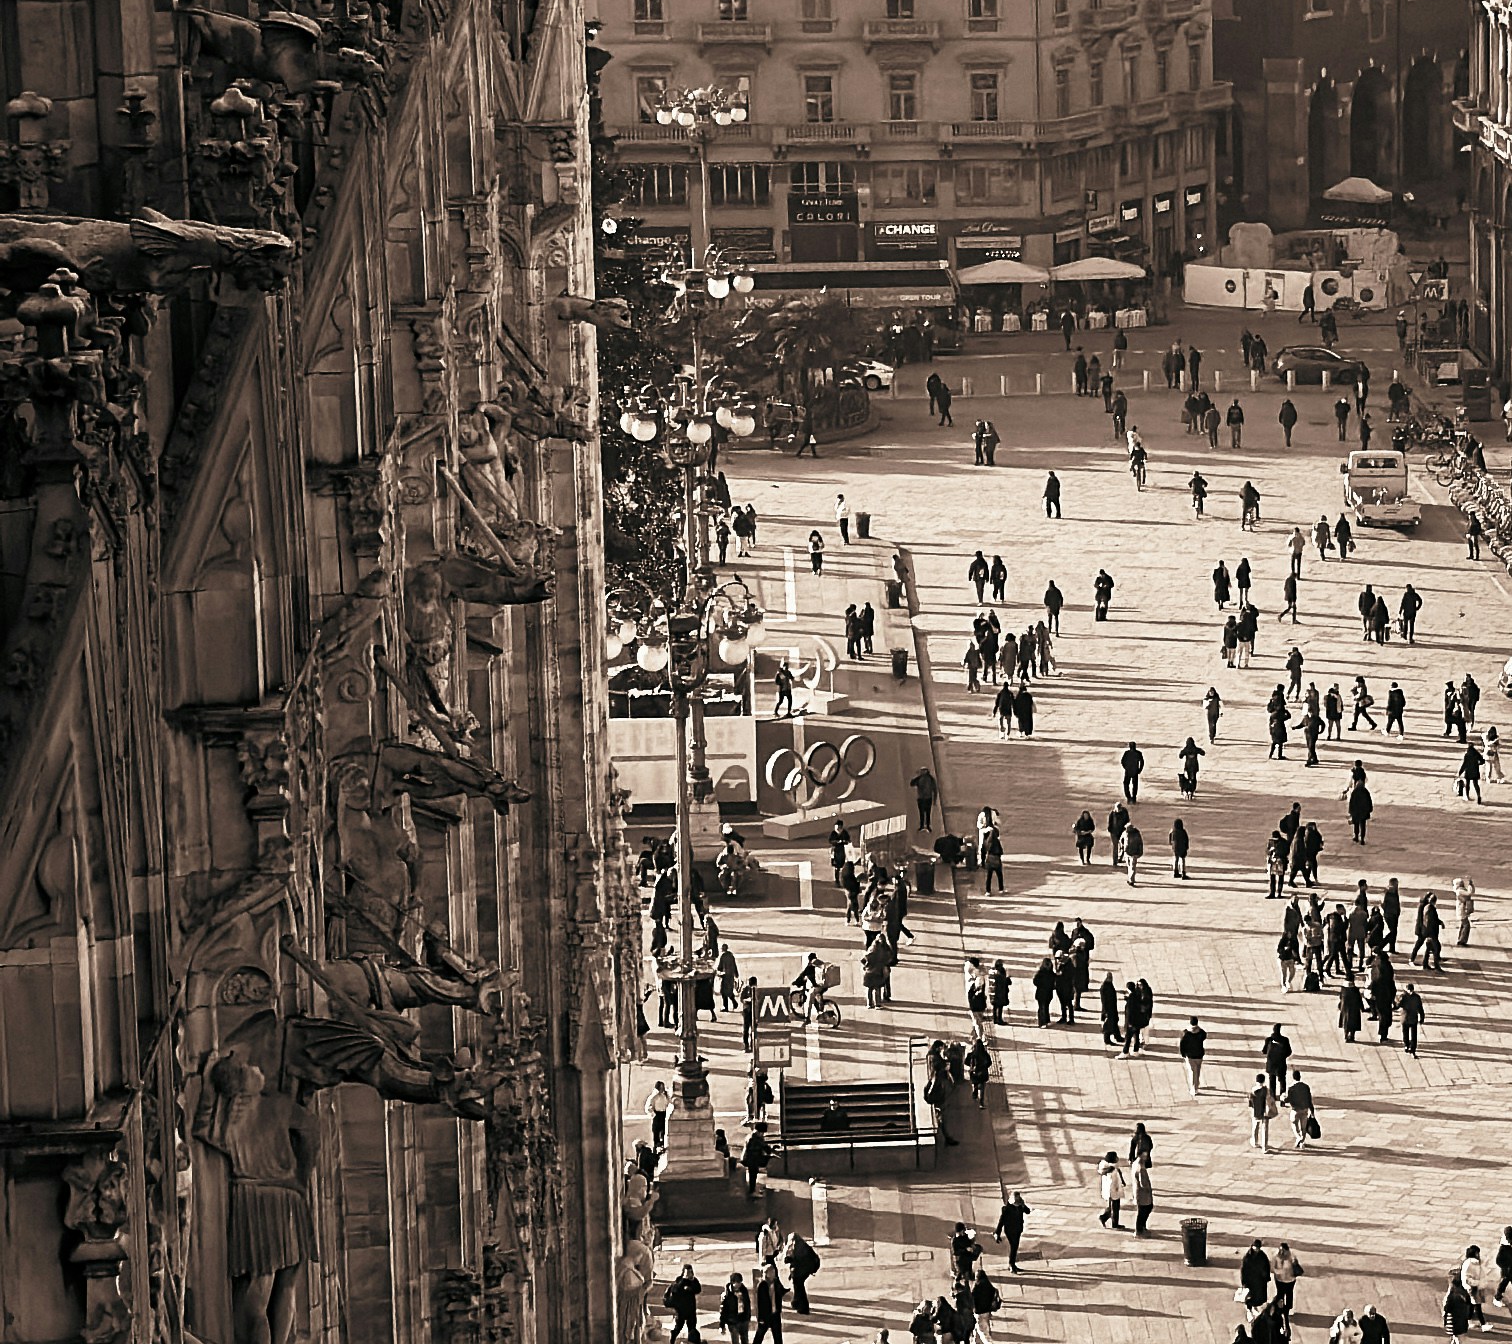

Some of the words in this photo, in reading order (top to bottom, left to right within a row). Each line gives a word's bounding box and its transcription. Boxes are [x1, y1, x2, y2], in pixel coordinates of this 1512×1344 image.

[885, 224, 936, 235] CHANGE
[627, 235, 672, 247] change
[921, 293, 941, 301] TOUR
[759, 995, 789, 1017] M
